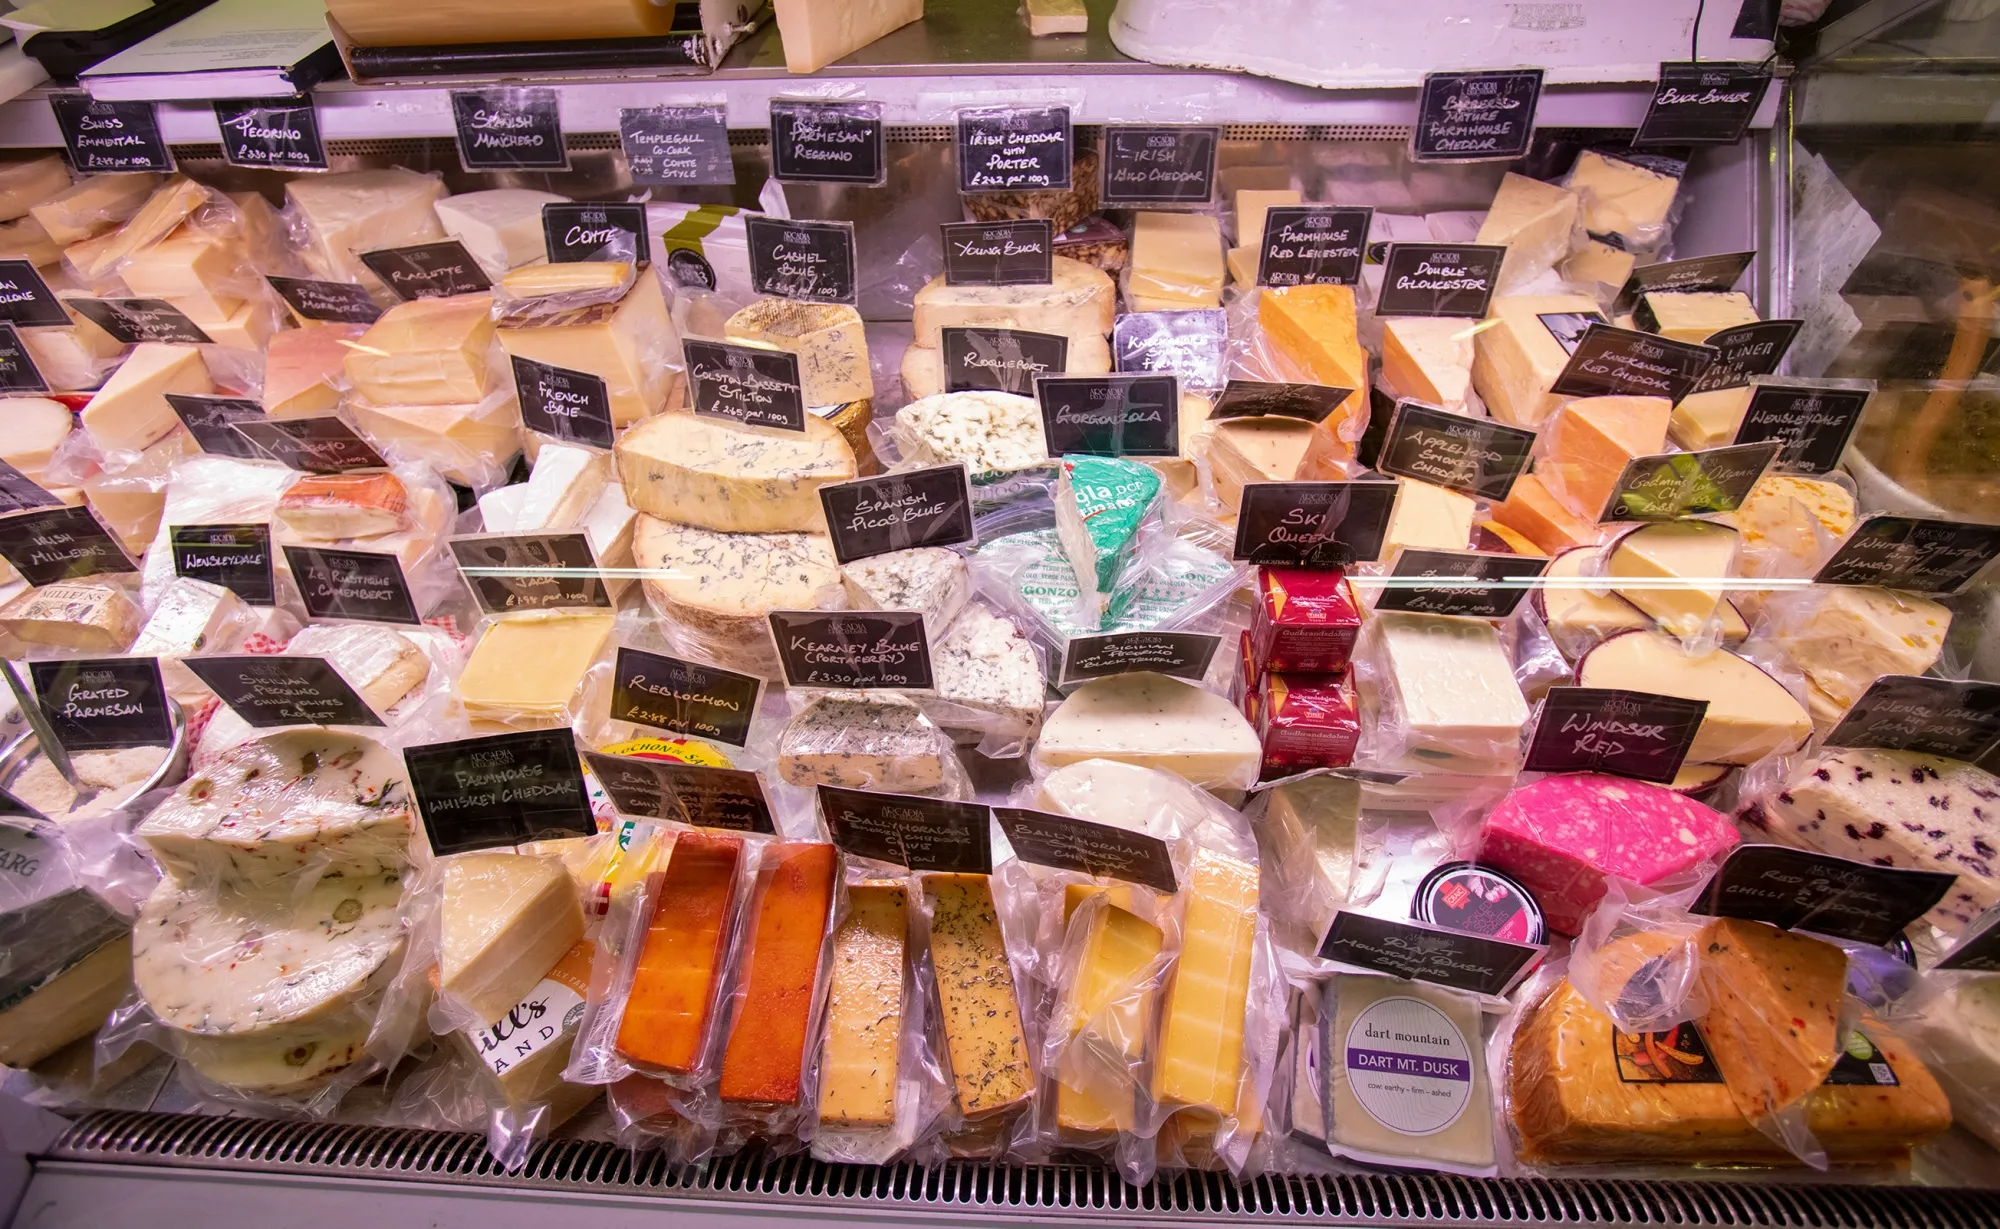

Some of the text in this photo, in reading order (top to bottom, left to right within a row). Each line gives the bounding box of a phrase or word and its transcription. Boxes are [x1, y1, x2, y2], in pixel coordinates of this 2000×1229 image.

[235, 116, 302, 139] PECORINO
[1430, 122, 1513, 138] FARMHOUSE
[473, 132, 544, 148] MANCHEGO
[1008, 131, 1065, 144] CHEDDAR
[1435, 138, 1498, 151] CHEDDAR
[794, 144, 853, 161] REGGIANO
[1134, 150, 1176, 163] IRISH
[986, 156, 1041, 170] PORTER
[1028, 174, 1051, 188] 100g
[1149, 169, 1206, 182] CHEDDAR
[1279, 224, 1350, 243] FARMHOUSE
[772, 244, 827, 263] CASHEL
[953, 241, 1043, 258] YOUNG BUCK
[1269, 244, 1360, 260] RED LEICESTER
[777, 262, 817, 277] BLUE
[1413, 262, 1467, 278] DOUBLE
[816, 287, 838, 298] 100g
[1396, 276, 1487, 292] GLOUCESTER
[692, 362, 801, 394] COLSTON BASSETT
[1578, 359, 1673, 392] RED CHEDDAR
[538, 382, 590, 406] FRENCH
[718, 384, 773, 404] STILTON
[542, 400, 582, 419] BRIE
[768, 412, 789, 426] 100g
[1055, 403, 1163, 427] GORGONZOLA
[1750, 410, 1848, 427] WENSLEYDALE
[1405, 429, 1503, 463] APPLEWOOD
[1418, 448, 1480, 470] SMOKED
[1411, 460, 1474, 485] CHEDDAR
[852, 490, 929, 518] SPANISH
[902, 501, 947, 525] BLUE
[1280, 507, 1327, 526] SKI
[1267, 525, 1335, 544] QUEEN
[1852, 536, 1992, 560] WHITE STILTON
[185, 553, 263, 570] WENSLEYDALE
[1832, 556, 1894, 572] MANGO
[515, 576, 561, 589] JACK
[317, 586, 396, 602] CAMEMBERT
[1282, 629, 1352, 639] Gudbrandsdalen
[790, 638, 921, 658] KEARNEY BLUE
[804, 652, 906, 665] (PORTAFERRY)
[237, 673, 311, 686] SICILIAN
[880, 673, 908, 686] 100g
[68, 683, 130, 702] GRATED
[628, 674, 740, 712] REBLOCHON
[63, 701, 145, 721] PARMESAN
[1871, 699, 1995, 723] WENSLYDALE
[694, 722, 721, 737] 100g
[1279, 730, 1350, 740] Gudbrandsdalen
[1560, 711, 1667, 741] WINDSOR
[1572, 733, 1626, 758] RED
[454, 764, 544, 791] FARMHOUSE
[429, 781, 579, 816] WHISKEY CHEDDAR
[839, 809, 971, 837] BALLYHORNAN
[1014, 824, 1151, 860] BALLYHORNAN
[1448, 887, 1465, 904] CRAIC
[1334, 937, 1495, 978] MOUNTAIN DUSK
[1364, 1023, 1451, 1047] dart mountain
[1357, 1053, 1460, 1077] DART MT. DUSK
[1367, 1082, 1453, 1099] cow: earthy firm ashed
